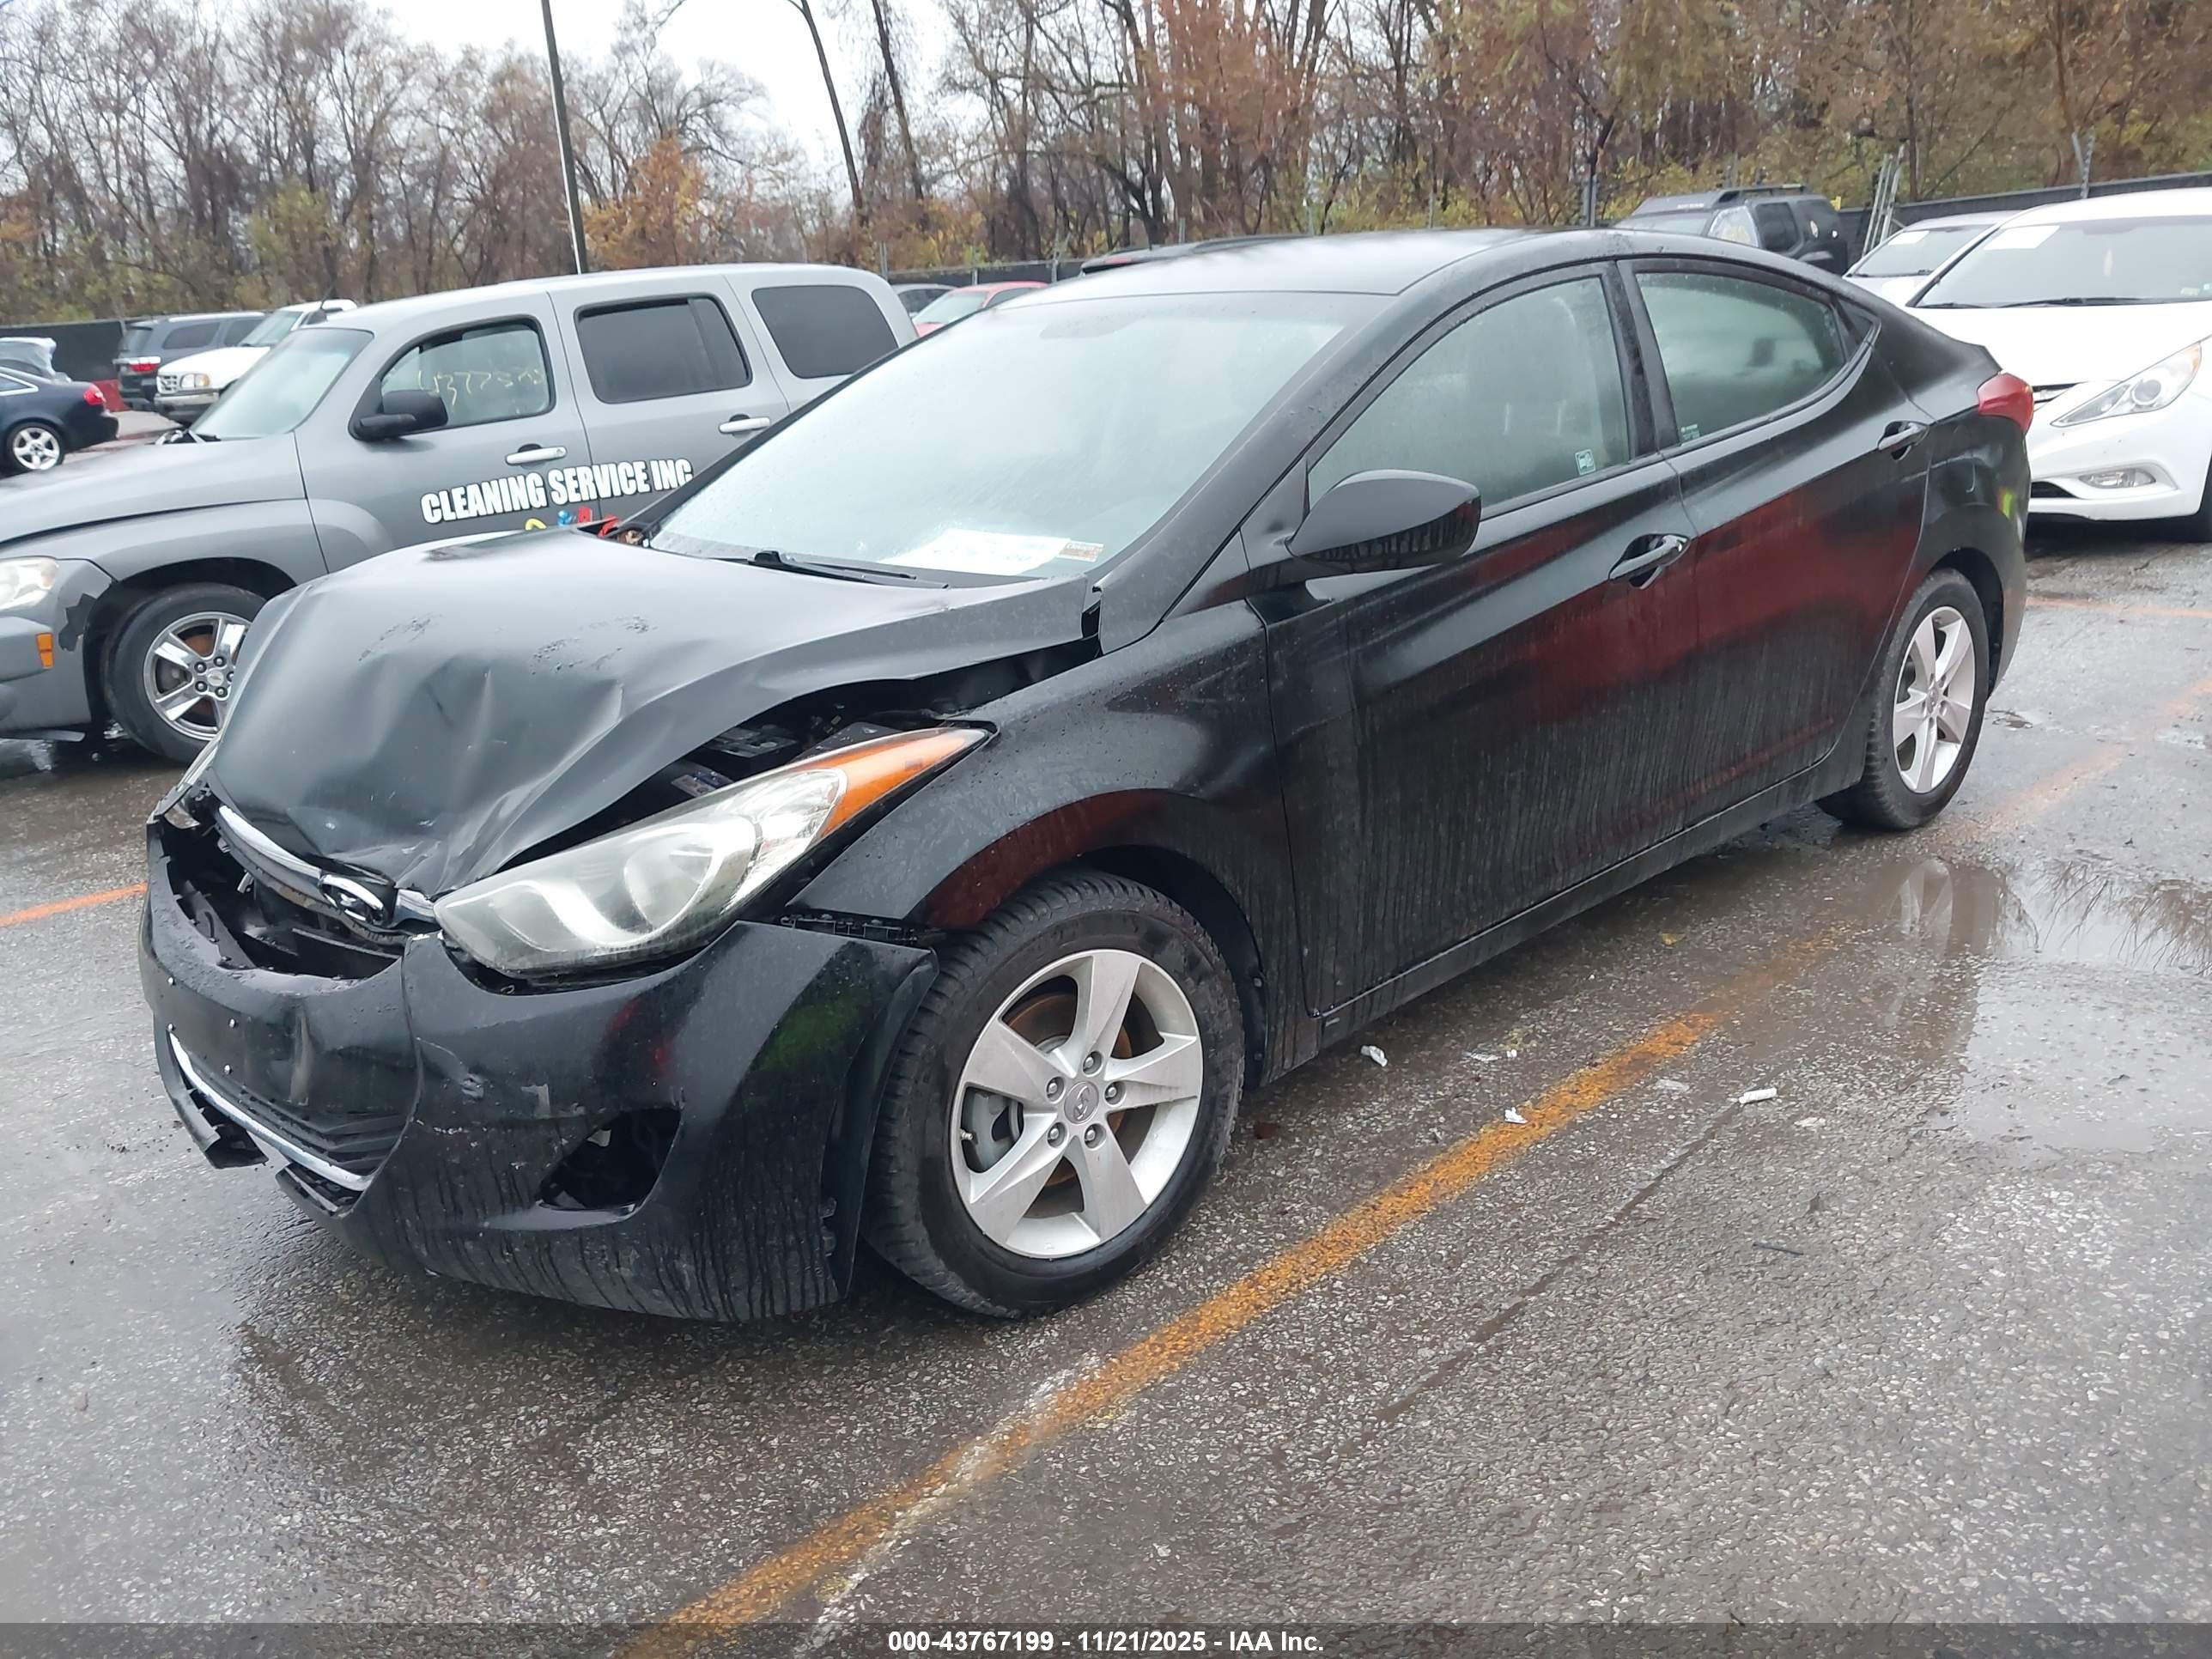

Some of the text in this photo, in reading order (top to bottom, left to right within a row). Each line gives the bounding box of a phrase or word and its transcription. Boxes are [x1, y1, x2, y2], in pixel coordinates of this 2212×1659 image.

[421, 459, 693, 524] CLEANING SERVICE INC
